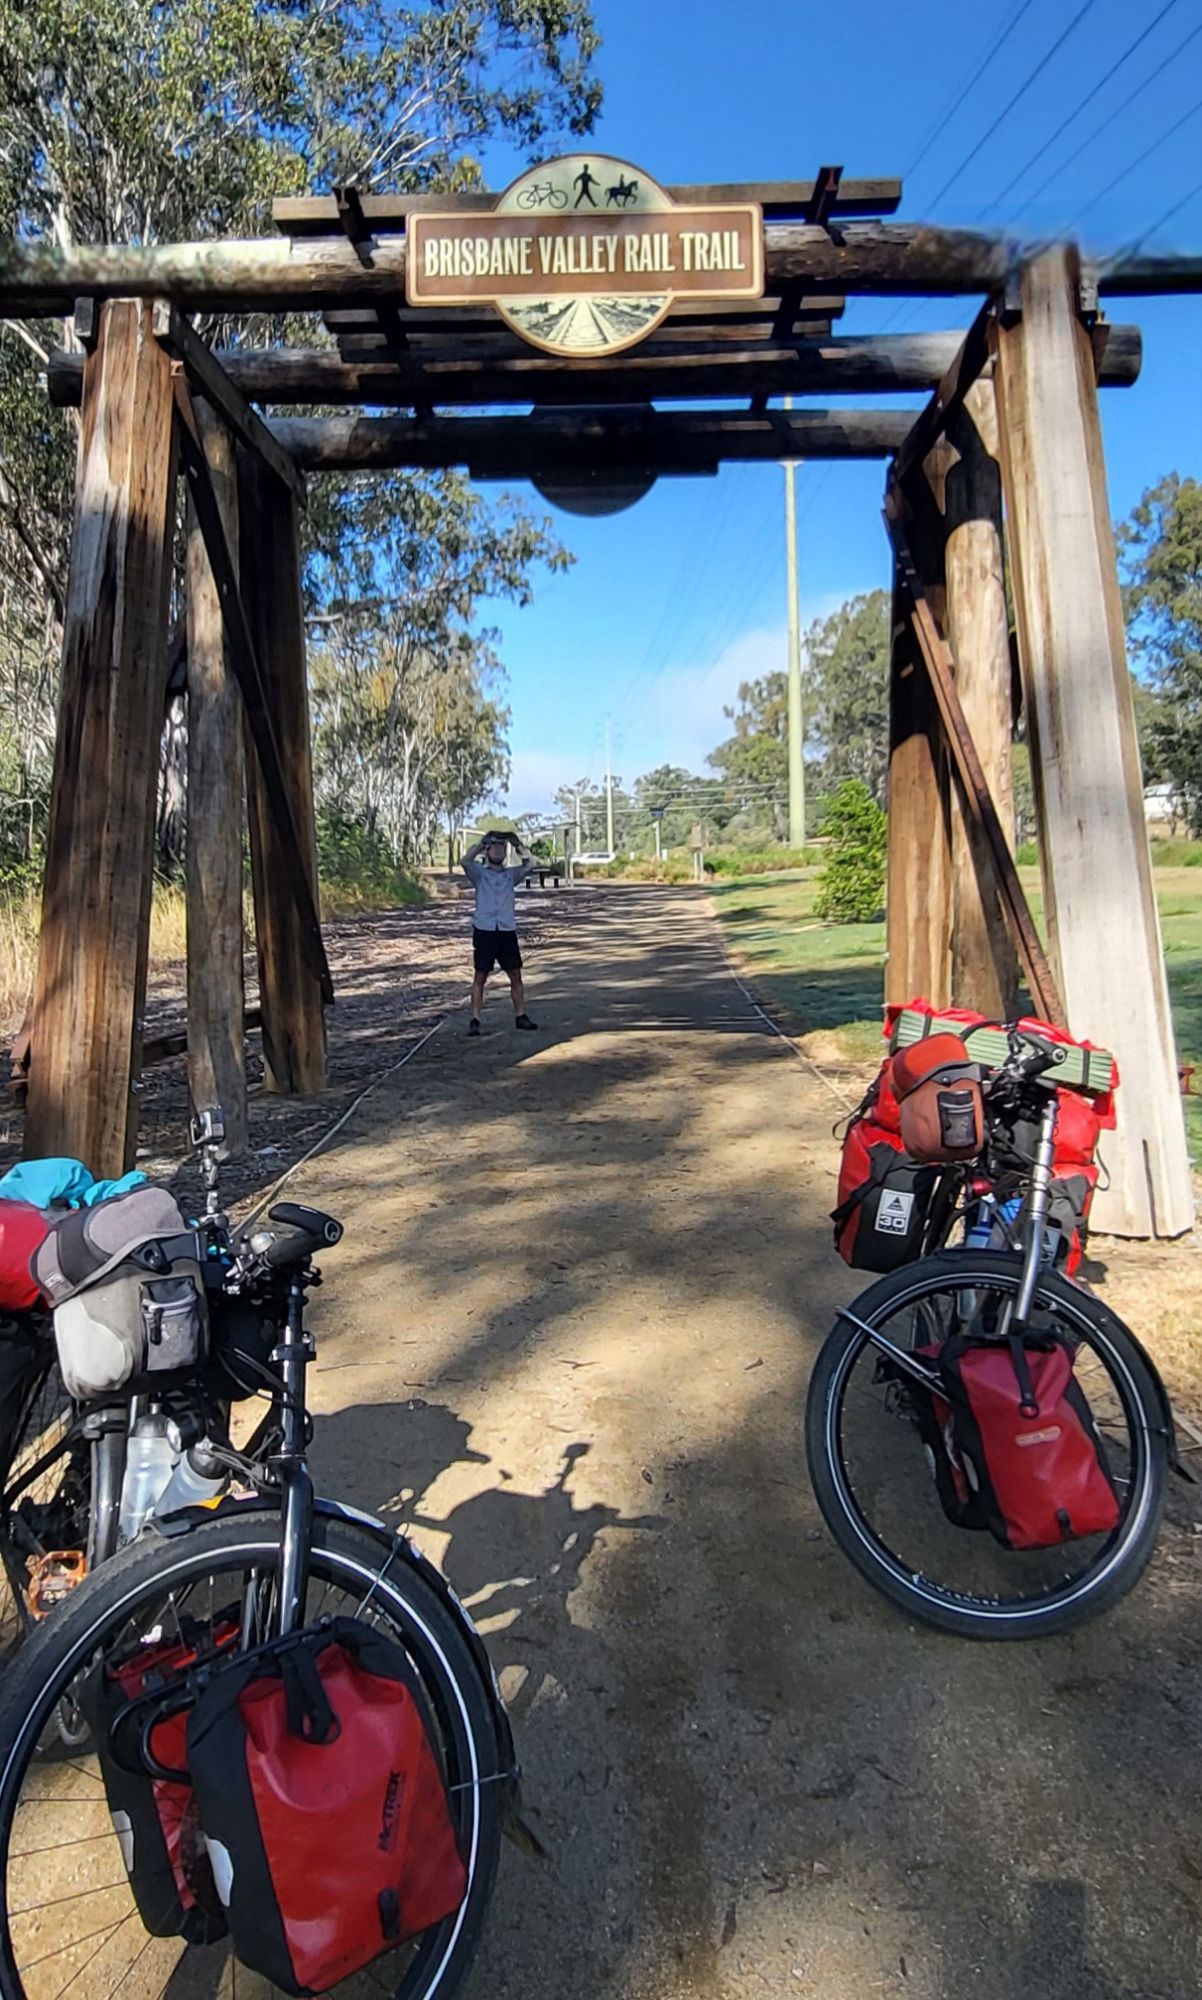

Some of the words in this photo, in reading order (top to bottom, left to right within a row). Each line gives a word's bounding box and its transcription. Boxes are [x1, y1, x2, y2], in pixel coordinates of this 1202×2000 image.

[424, 236, 533, 277] BRISBANE
[537, 233, 618, 274] VALLEY
[624, 232, 675, 272] RAIL
[679, 231, 745, 270] TRAIL
[879, 1216, 905, 1229] 30
